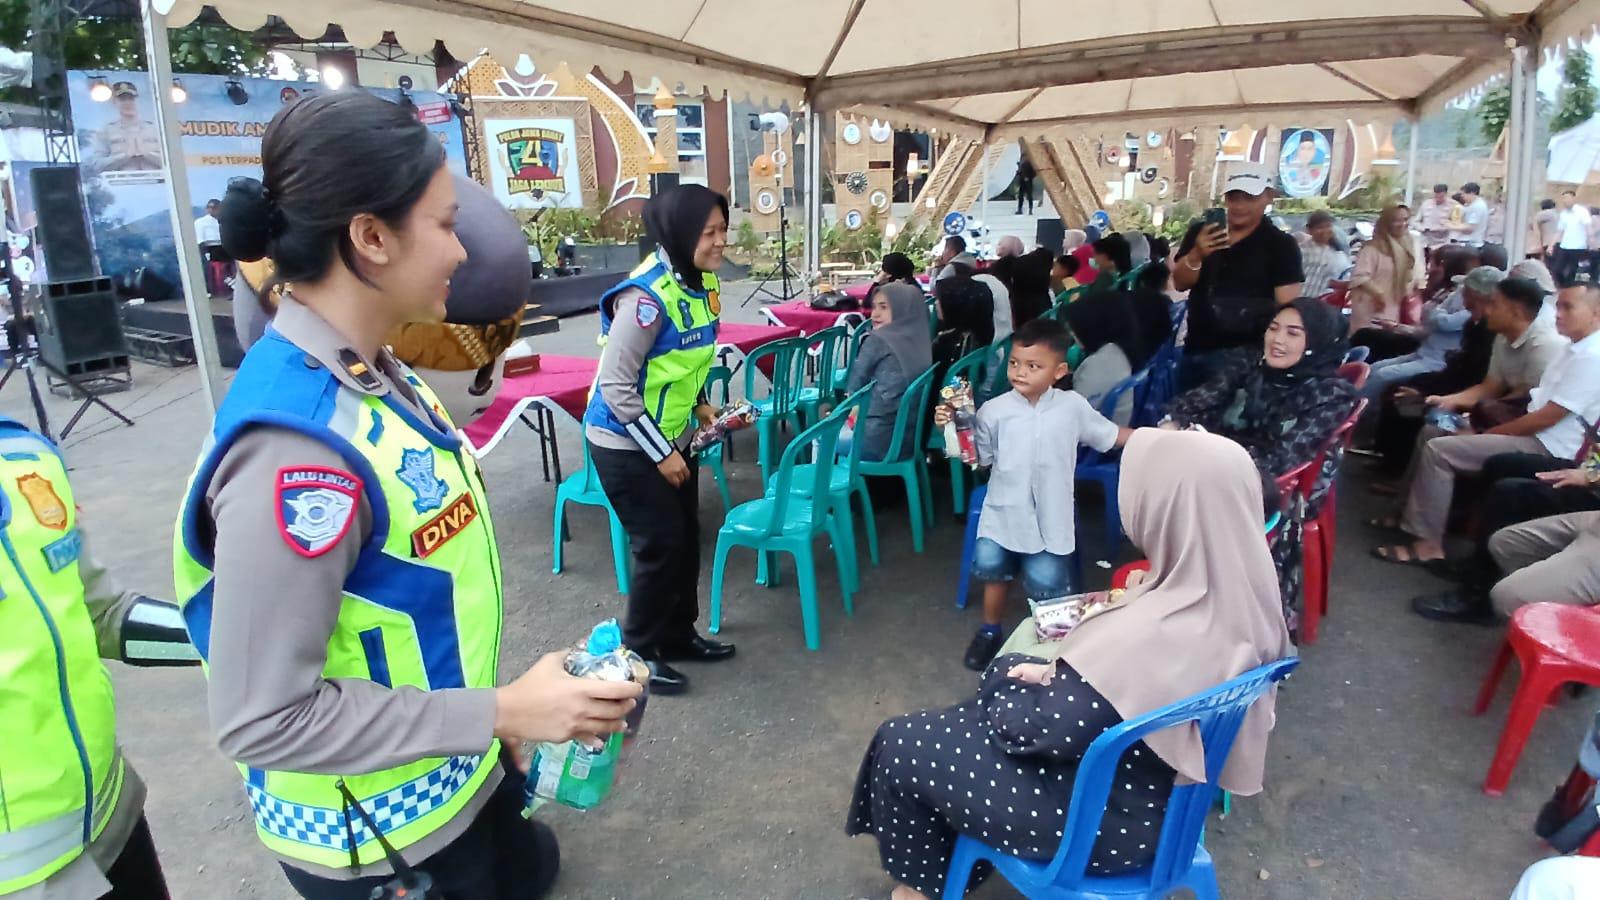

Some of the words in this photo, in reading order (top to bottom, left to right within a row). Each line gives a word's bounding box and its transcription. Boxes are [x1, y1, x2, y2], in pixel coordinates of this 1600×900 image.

[178, 121, 239, 137] MUDIK
[202, 156, 222, 165] POS
[283, 472, 318, 483] LALU
[318, 472, 357, 490] LINTAS
[422, 502, 472, 550] DIVA
